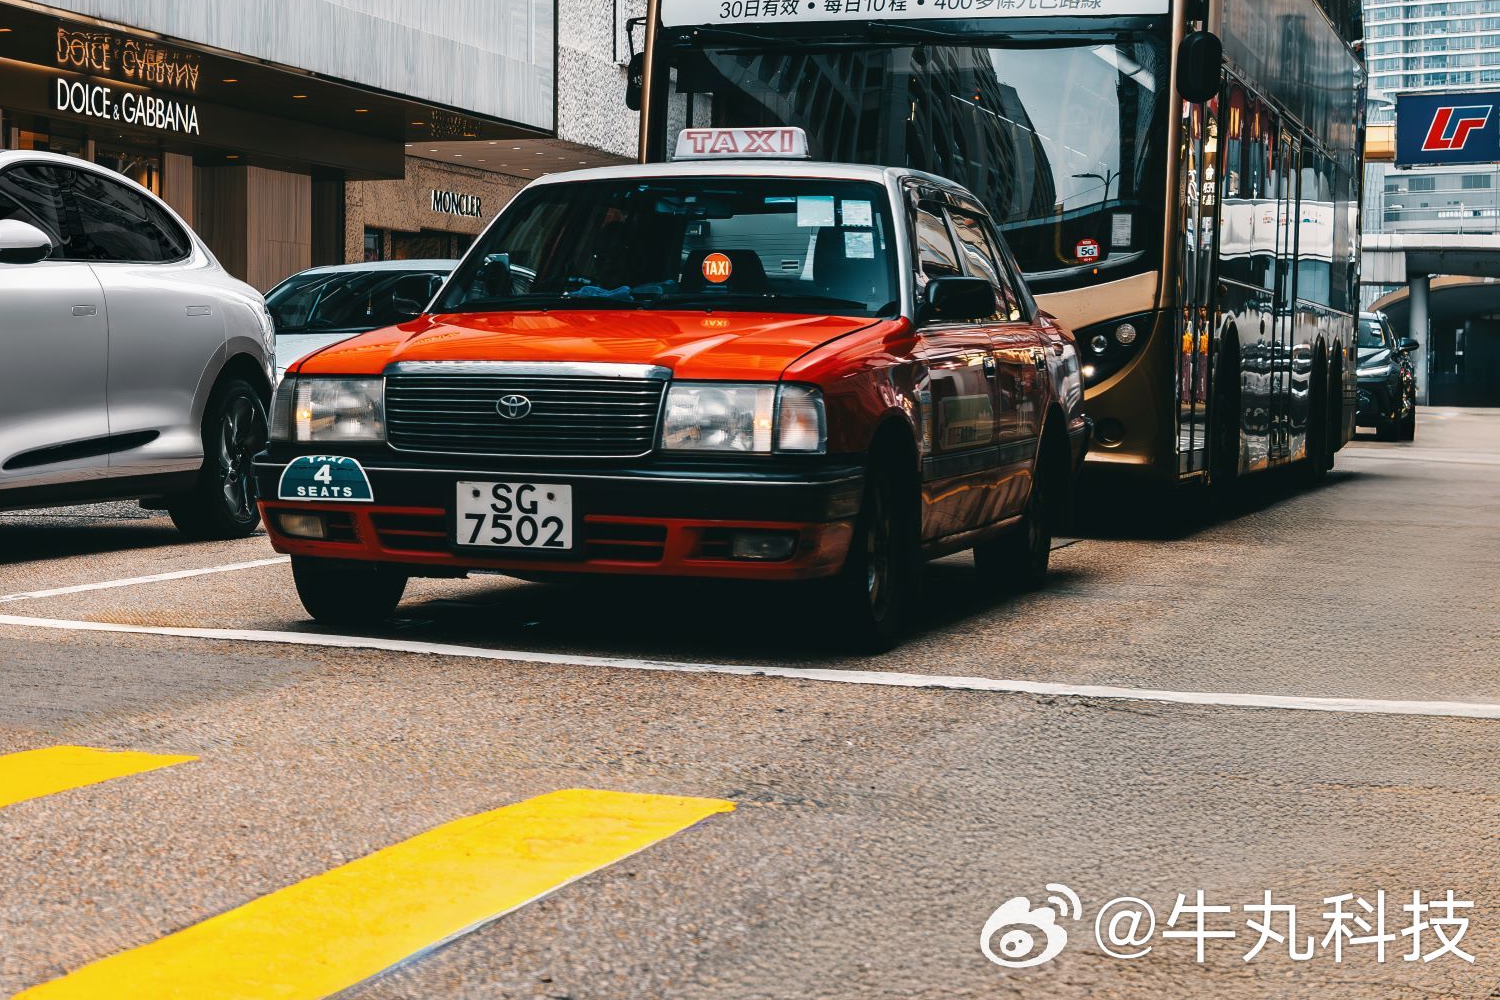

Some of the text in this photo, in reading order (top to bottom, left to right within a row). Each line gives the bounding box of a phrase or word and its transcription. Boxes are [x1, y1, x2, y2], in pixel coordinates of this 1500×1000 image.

[57, 78, 200, 136] DOLCE & GABBANA
[686, 129, 795, 154] TAXI
[431, 189, 483, 218] MONCLER
[704, 260, 729, 276] TAXI
[313, 464, 333, 485] 4
[296, 485, 353, 498] SEATS
[490, 483, 539, 515] SG
[464, 512, 565, 548] 7502
